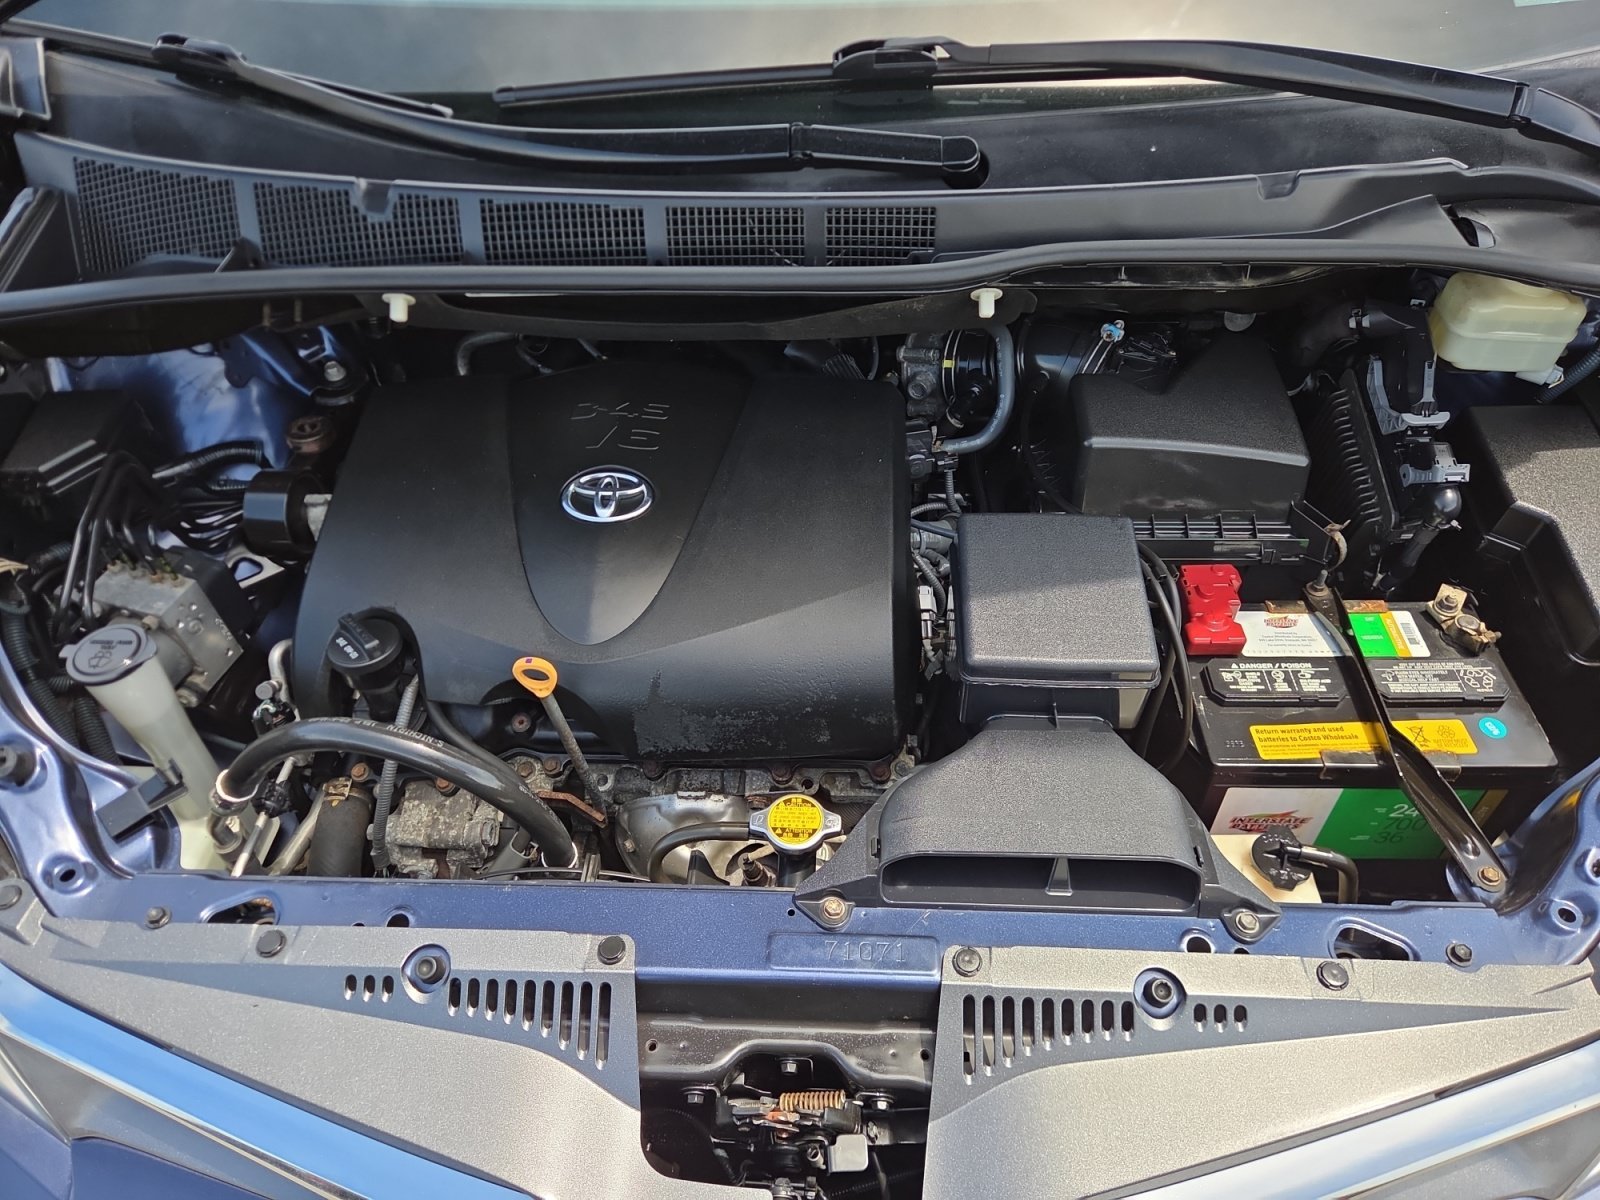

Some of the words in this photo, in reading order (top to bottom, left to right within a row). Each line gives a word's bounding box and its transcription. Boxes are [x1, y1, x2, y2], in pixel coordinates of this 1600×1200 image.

[1280, 727, 1312, 735] warranty
[1298, 734, 1322, 742] Costco
[1228, 816, 1311, 825] INTERSTATE
[1383, 817, 1428, 831] 700
[1373, 831, 1404, 843] 36
[824, 940, 906, 962] 71071
